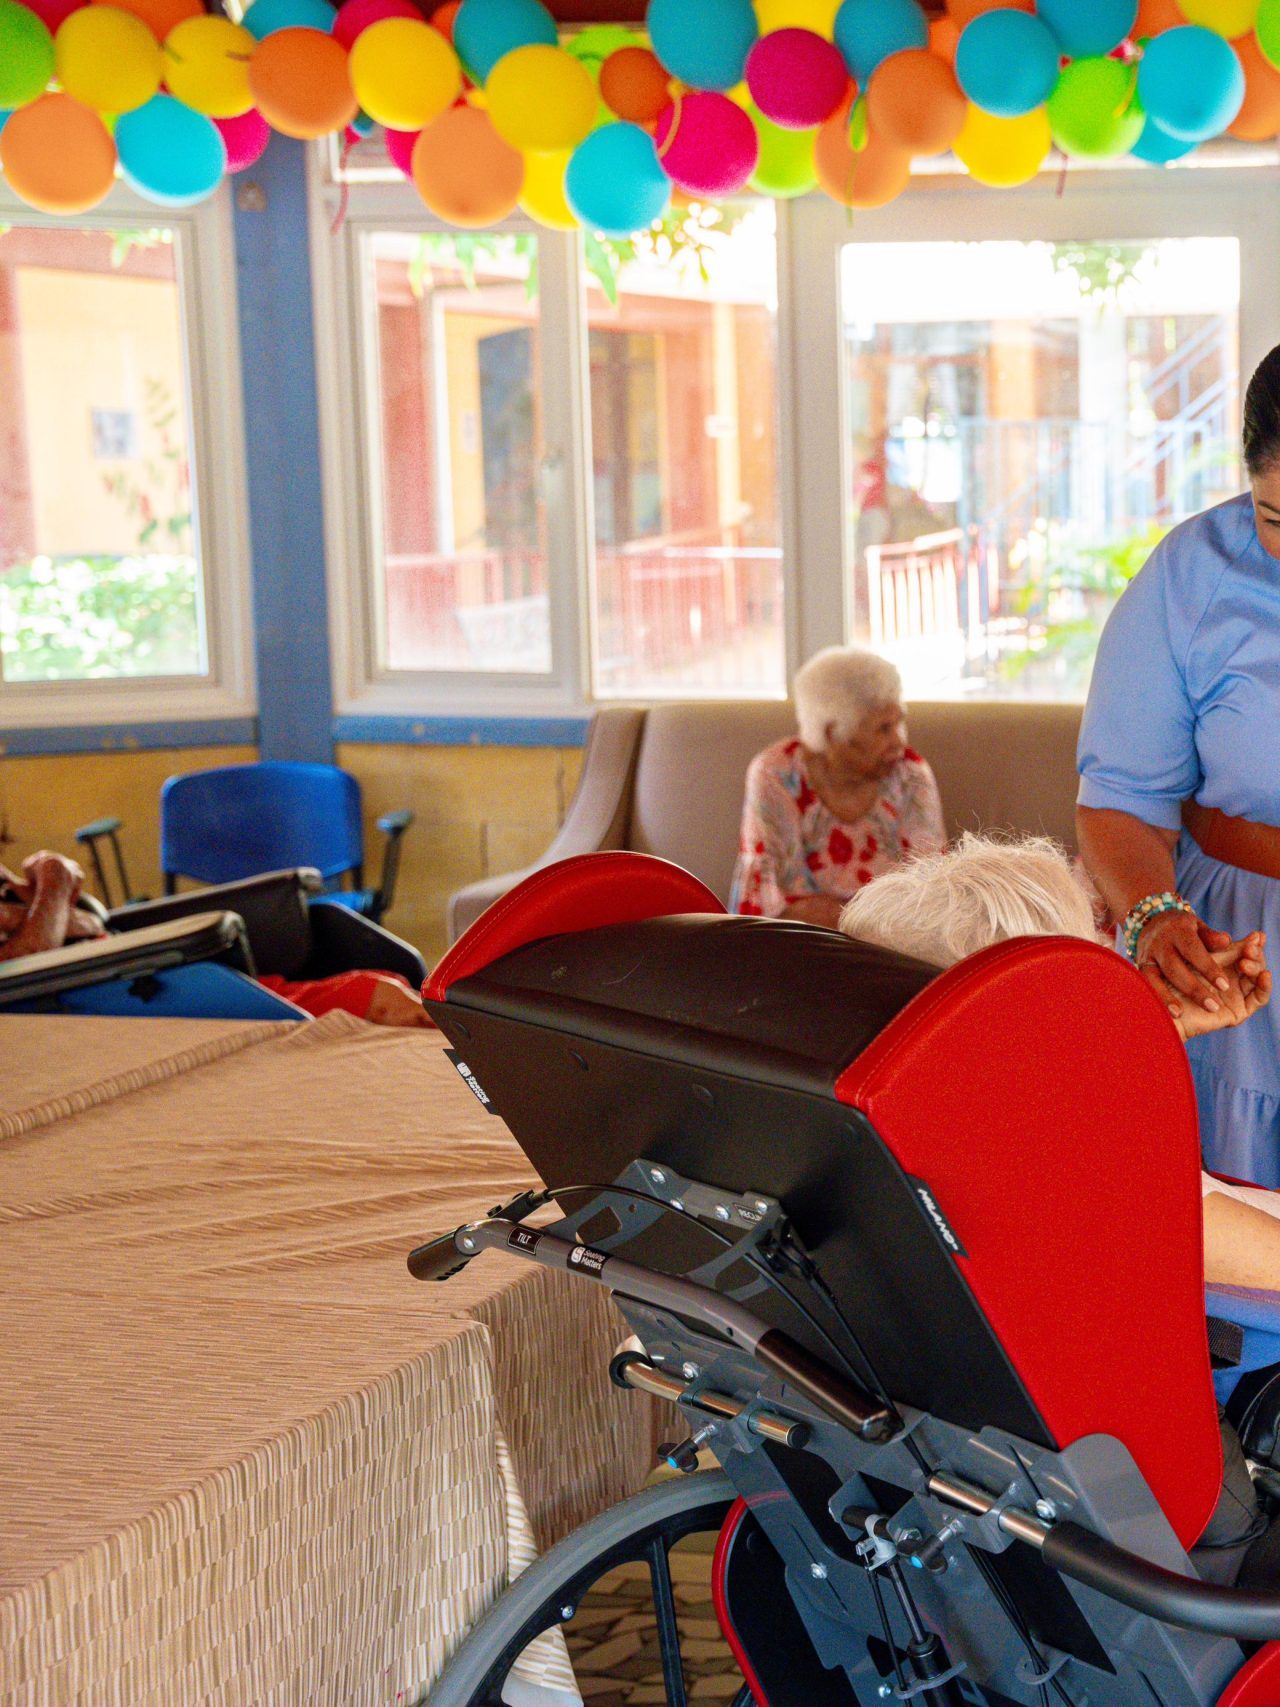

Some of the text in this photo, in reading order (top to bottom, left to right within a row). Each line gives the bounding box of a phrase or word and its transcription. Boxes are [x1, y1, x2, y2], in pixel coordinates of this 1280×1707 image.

[517, 1232, 532, 1244] TILT
[584, 1249, 606, 1262] Seating
[580, 1258, 603, 1270] Matters
